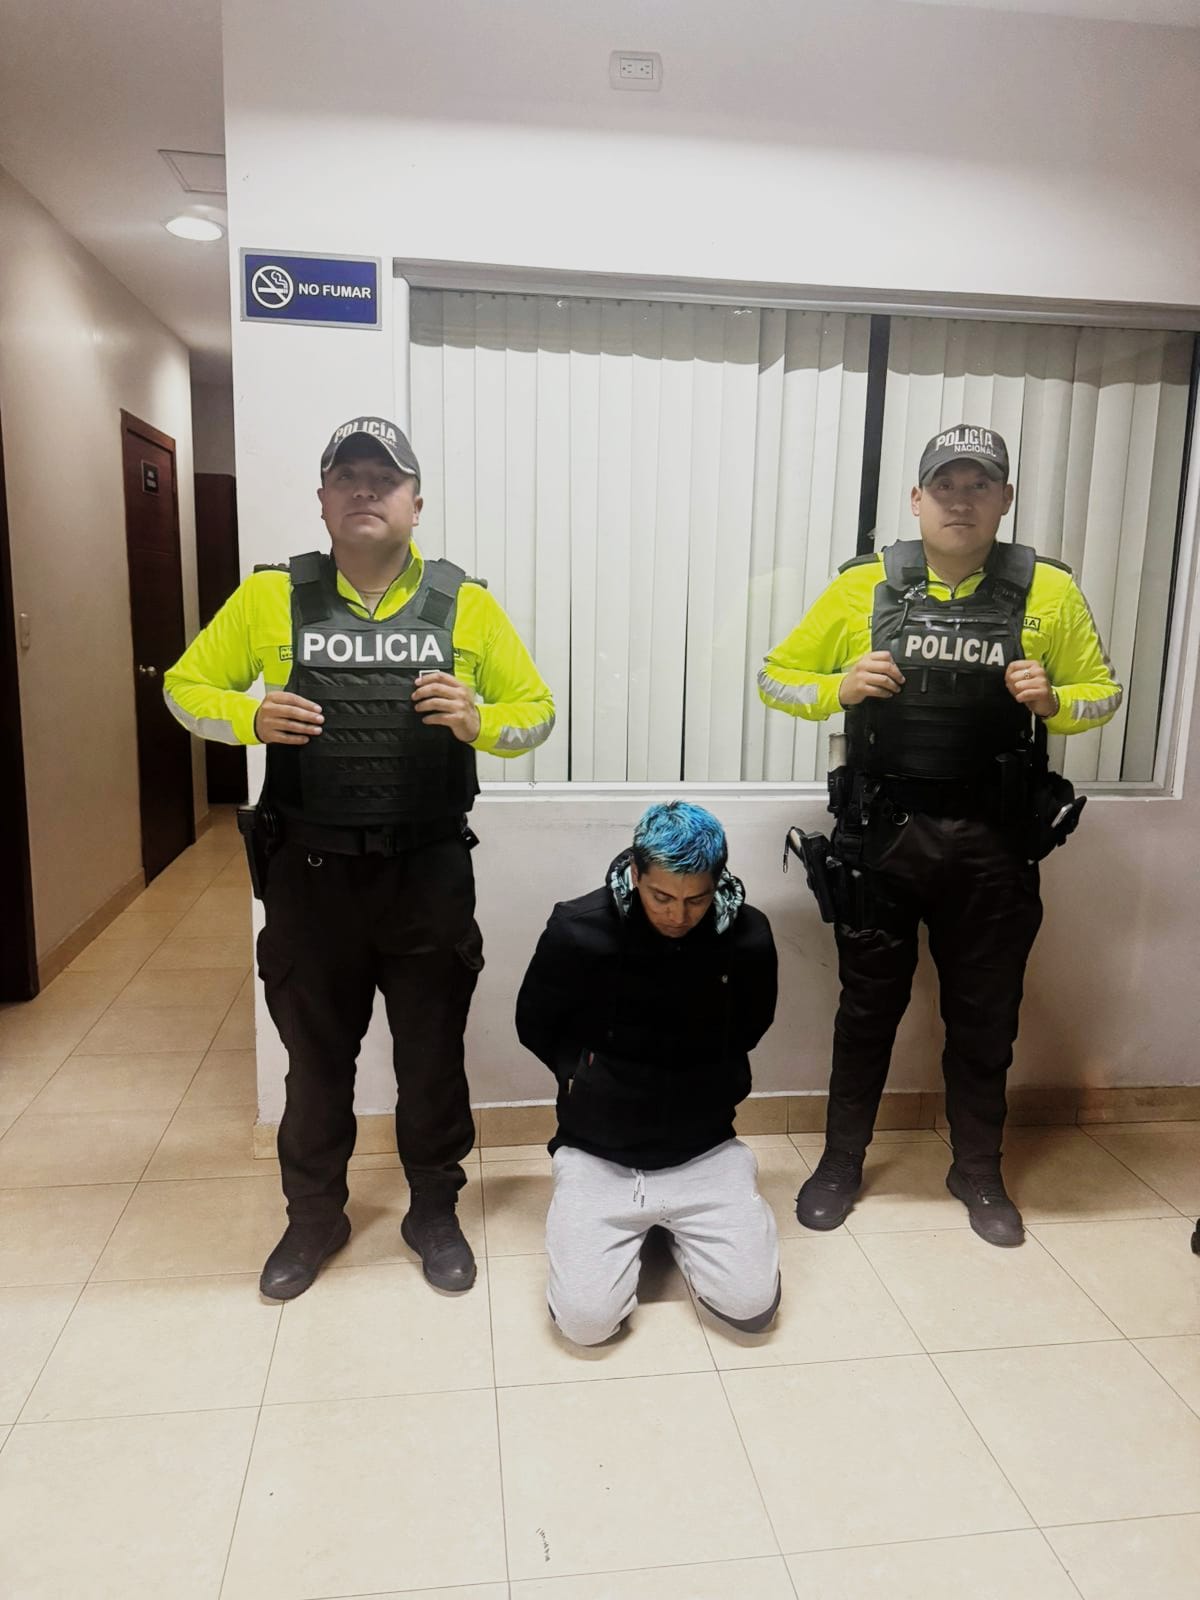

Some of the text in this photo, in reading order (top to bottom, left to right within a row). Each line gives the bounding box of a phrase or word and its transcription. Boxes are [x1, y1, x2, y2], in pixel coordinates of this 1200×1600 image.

[298, 283, 371, 299] NO FUMAR
[954, 445, 997, 457] NACIONAL
[303, 632, 444, 662] POLICIA
[905, 635, 1005, 666] POLICIA
